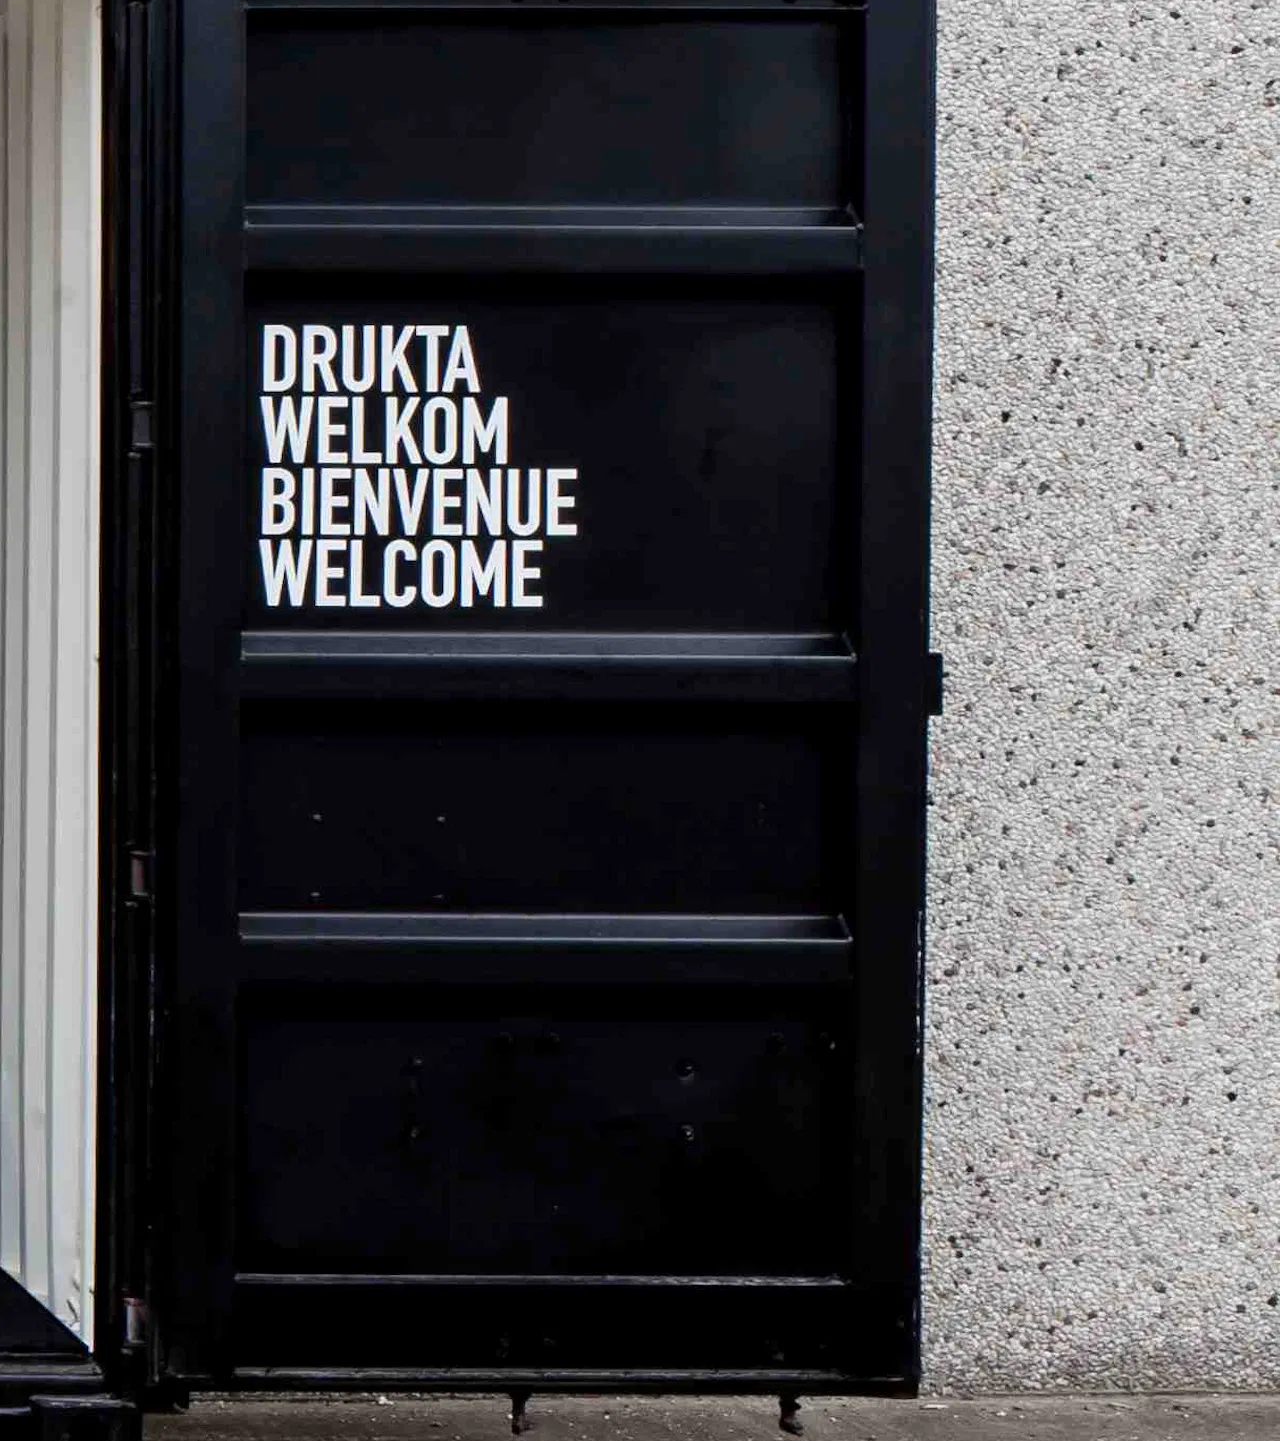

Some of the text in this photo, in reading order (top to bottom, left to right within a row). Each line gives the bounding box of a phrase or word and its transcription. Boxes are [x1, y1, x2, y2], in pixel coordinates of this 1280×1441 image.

[263, 325, 480, 393] DRUKTA
[260, 396, 508, 464] WELKOM
[262, 468, 577, 536] BIENVENUE
[259, 539, 543, 607] WELCOME
